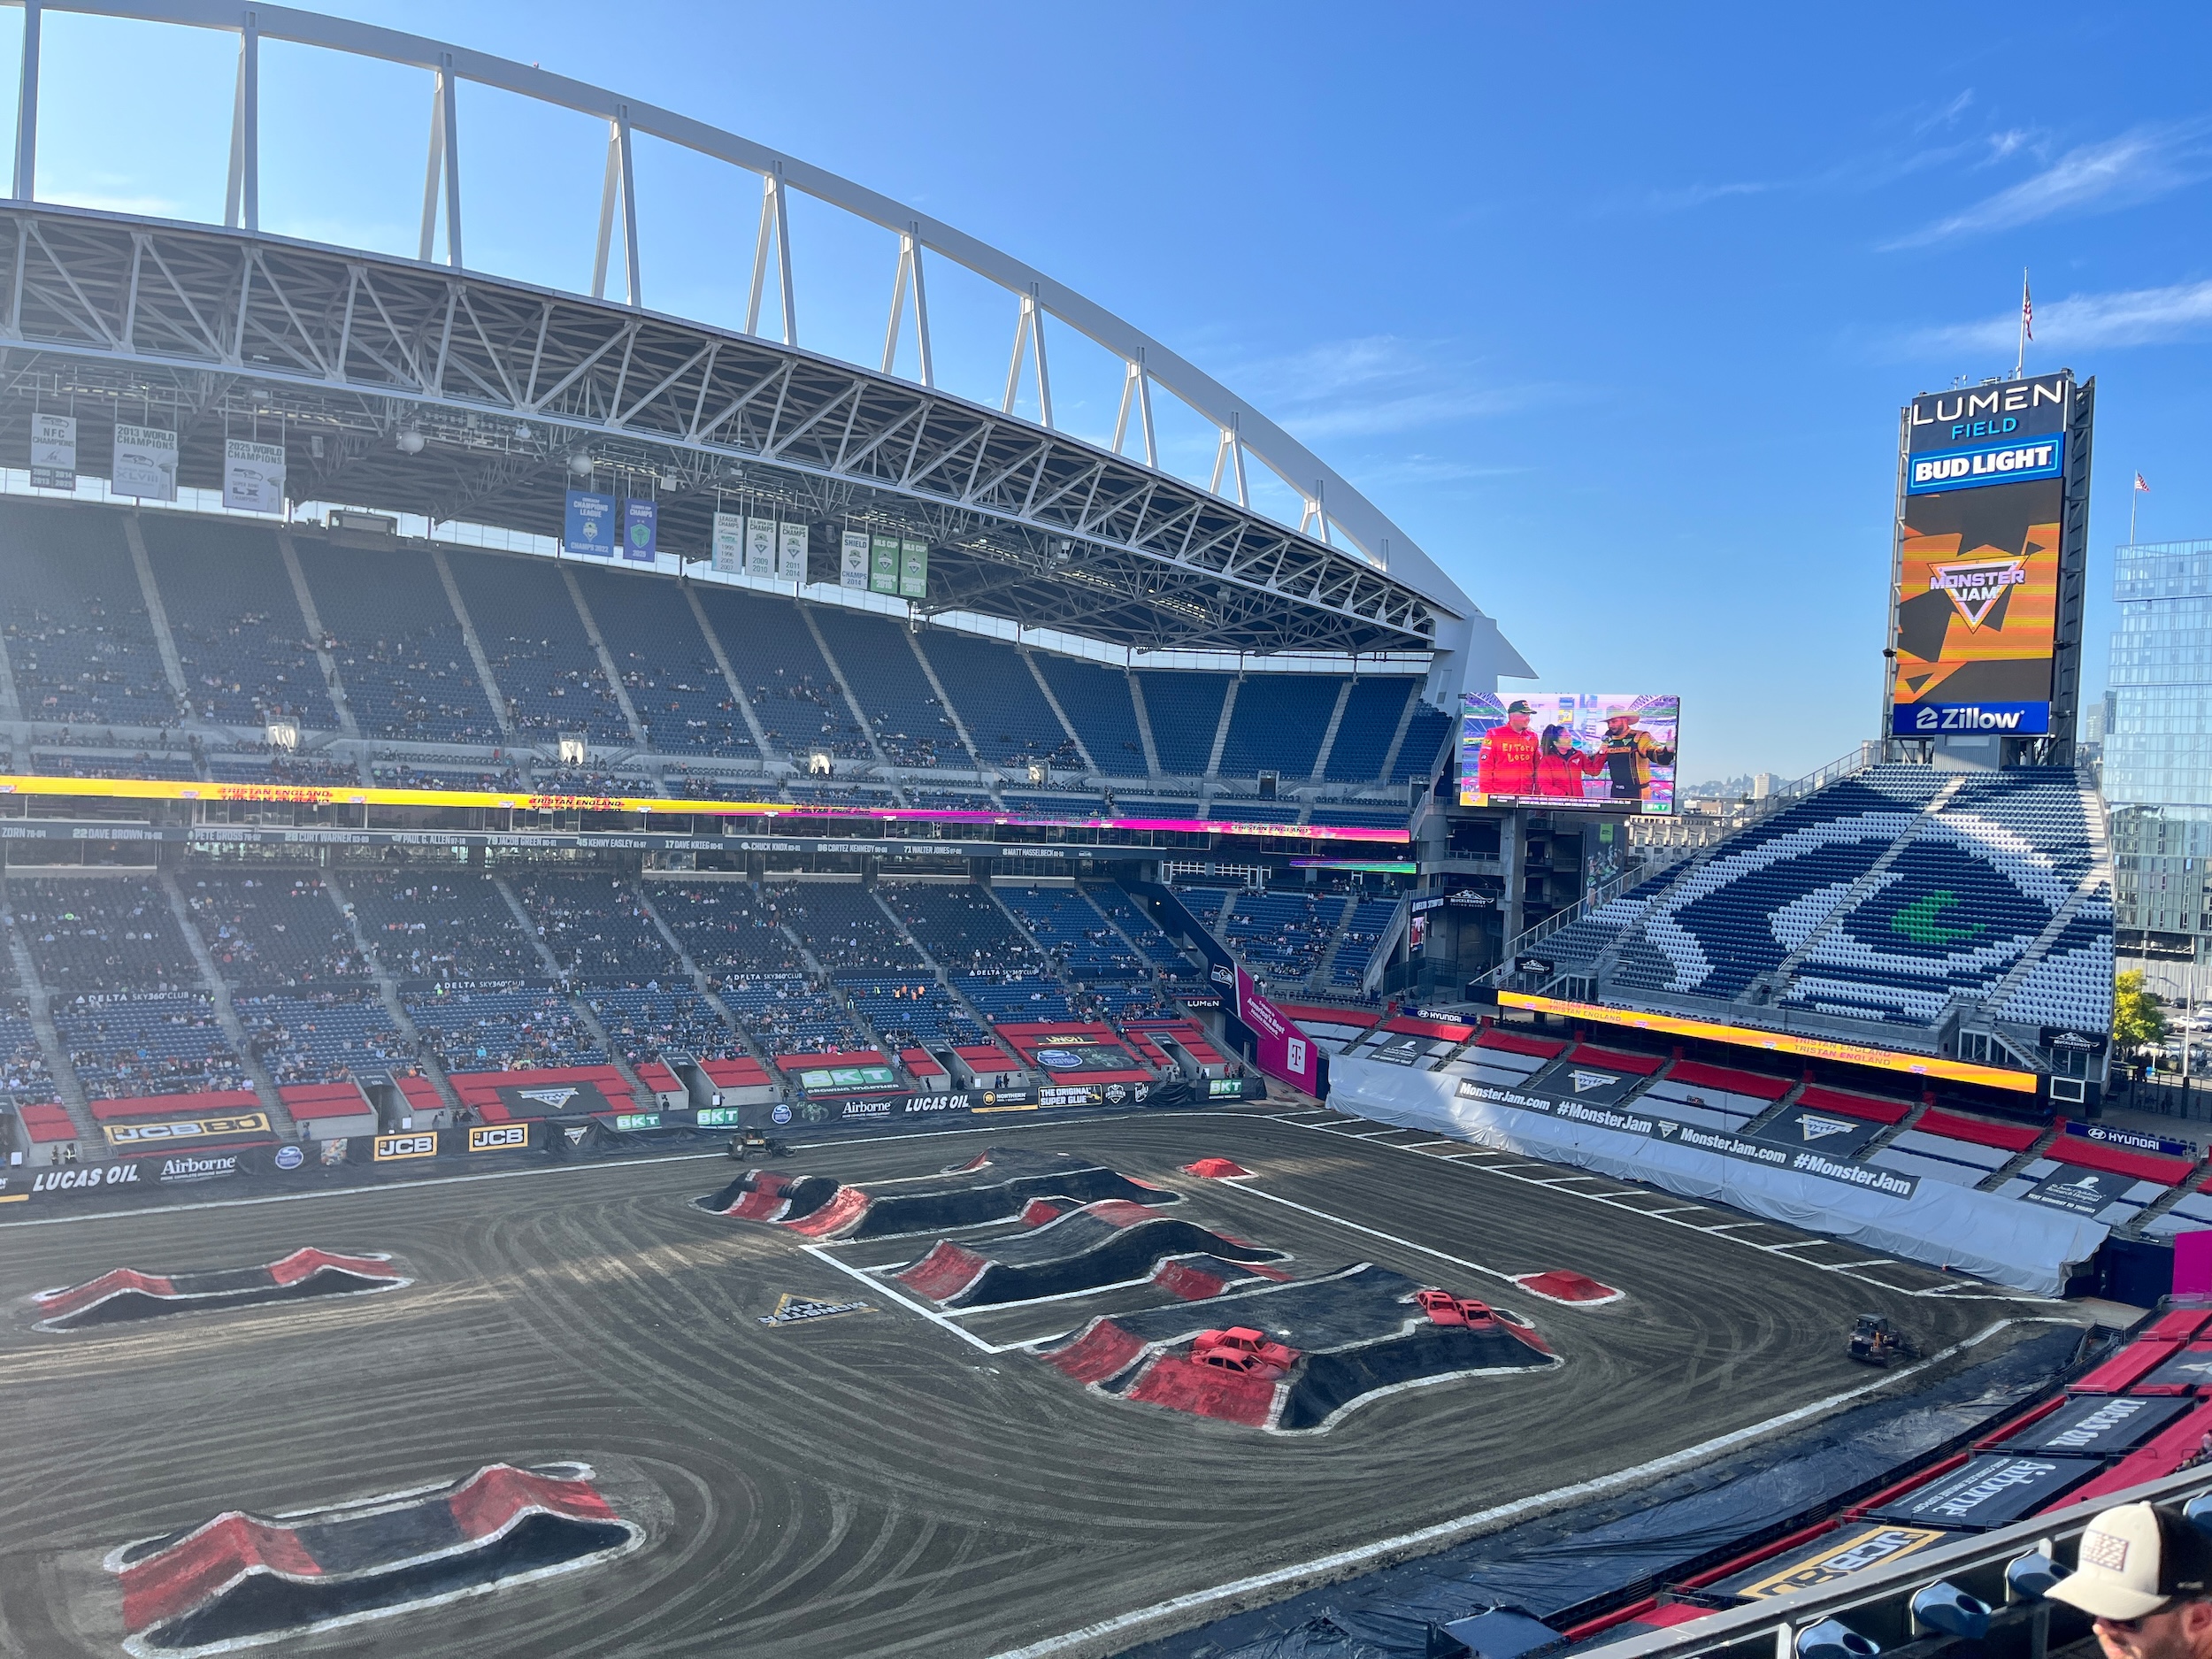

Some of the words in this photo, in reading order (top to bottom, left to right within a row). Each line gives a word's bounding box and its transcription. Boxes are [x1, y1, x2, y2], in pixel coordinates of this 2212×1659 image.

[1913, 380, 2063, 426] LUMEN
[43, 427, 65, 438] NFC
[118, 426, 140, 437] 2013
[143, 429, 174, 442] WORLD
[1952, 417, 2018, 440] FIELD
[33, 436, 74, 448] CHAMPIONS
[117, 435, 174, 450] CHAMPIONS
[228, 442, 250, 452] 2025
[252, 444, 282, 457] WORLD
[227, 449, 282, 465] CHAMPIONS
[1916, 457, 1970, 482] BUD
[1973, 445, 2053, 475] LIGHT
[116, 470, 158, 482] XLVIII
[233, 487, 258, 496] LX
[573, 501, 609, 511] CHAMPIONS
[580, 509, 602, 518] LEAGUE
[630, 509, 652, 518] CHAMPS
[749, 524, 774, 533] CHAMPS
[782, 529, 805, 538] CHAMPS
[571, 541, 594, 551] CHAMPS
[844, 539, 867, 548] SHIELD
[874, 539, 886, 548] MLS
[916, 544, 927, 553] CUP
[842, 571, 867, 580] CHAMPS
[872, 572, 896, 582] CHAMPS
[1930, 570, 2024, 590] MONSTER
[1955, 587, 1998, 602] JAM
[1941, 708, 2022, 729] Zillow
[533, 796, 573, 805] TRISTAN
[576, 798, 621, 807] ENGLAND
[2, 827, 26, 838] ZORN
[73, 828, 88, 839] 22
[88, 828, 110, 839] DAVE
[111, 829, 142, 840] BROWN
[195, 831, 215, 841] PETE
[216, 832, 243, 841] GROSS
[299, 832, 319, 842] CURT
[320, 833, 352, 843] WARNER
[403, 834, 420, 844] PAUL
[430, 835, 451, 845] ALLEN
[488, 836, 497, 846] 79
[498, 836, 519, 846] JACOB
[520, 837, 541, 847] GREEN
[576, 838, 588, 847] 45
[588, 838, 609, 848] KENNY
[610, 838, 634, 848] EASLEY
[665, 840, 674, 849] 17
[674, 840, 689, 849] DAVE
[691, 841, 710, 849] KRIEG
[751, 842, 771, 851] CHUCK
[772, 842, 787, 851] KNOX
[818, 843, 828, 852] 96
[828, 843, 849, 852] CORTEZ
[849, 844, 875, 853] KENNEDY
[903, 845, 911, 854] 71
[911, 845, 933, 854] WALTER
[933, 846, 950, 855] JONES
[1008, 848, 1022, 856] MATT
[88, 994, 127, 1002] DELTA
[1430, 1011, 1462, 1023] HYUNDAI
[1548, 1005, 1581, 1016] TRISTAN
[1583, 1010, 1622, 1022] ENGLAND
[1795, 1037, 1837, 1049] TRISTAN
[1840, 1044, 1892, 1057] ENGLAND
[2054, 1040, 2091, 1048] MUCKLESHOOT
[1794, 1045, 1837, 1058] TRISTAN
[1839, 1052, 1891, 1066] ENGLAND
[802, 1069, 887, 1085] BKT
[1041, 1088, 1055, 1097] THE
[1056, 1087, 1092, 1096] ORIGINAL
[1210, 1080, 1241, 1094] BKT
[905, 1096, 947, 1111] LUCAS
[949, 1094, 971, 1110] OIL
[1041, 1096, 1066, 1105] SUPER
[1068, 1095, 1087, 1104] GLUE
[842, 1101, 890, 1114] Airborne
[1460, 1082, 1551, 1111] MonsterJam.com
[1557, 1101, 1653, 1133] #MonsterJam
[618, 1115, 659, 1128] BKT
[697, 1110, 738, 1123] BKT
[1795, 1117, 1854, 1133] MONSTER
[474, 1129, 524, 1148] JCB
[2108, 1132, 2159, 1150] HYUNDAI
[380, 1138, 433, 1156] JCB
[160, 1156, 234, 1176] Airborne
[1680, 1127, 1786, 1164] MonsterJam.com
[1793, 1153, 1911, 1194] #MonsterJam
[33, 1167, 104, 1192] LUCAS
[106, 1164, 139, 1184] OIL
[757, 1301, 869, 1324] MONSTER
[780, 1302, 828, 1314] JAM
[2075, 1399, 2147, 1430] LUCAS
[2046, 1429, 2099, 1447] OIL
[1932, 1459, 2056, 1517] Airborne
